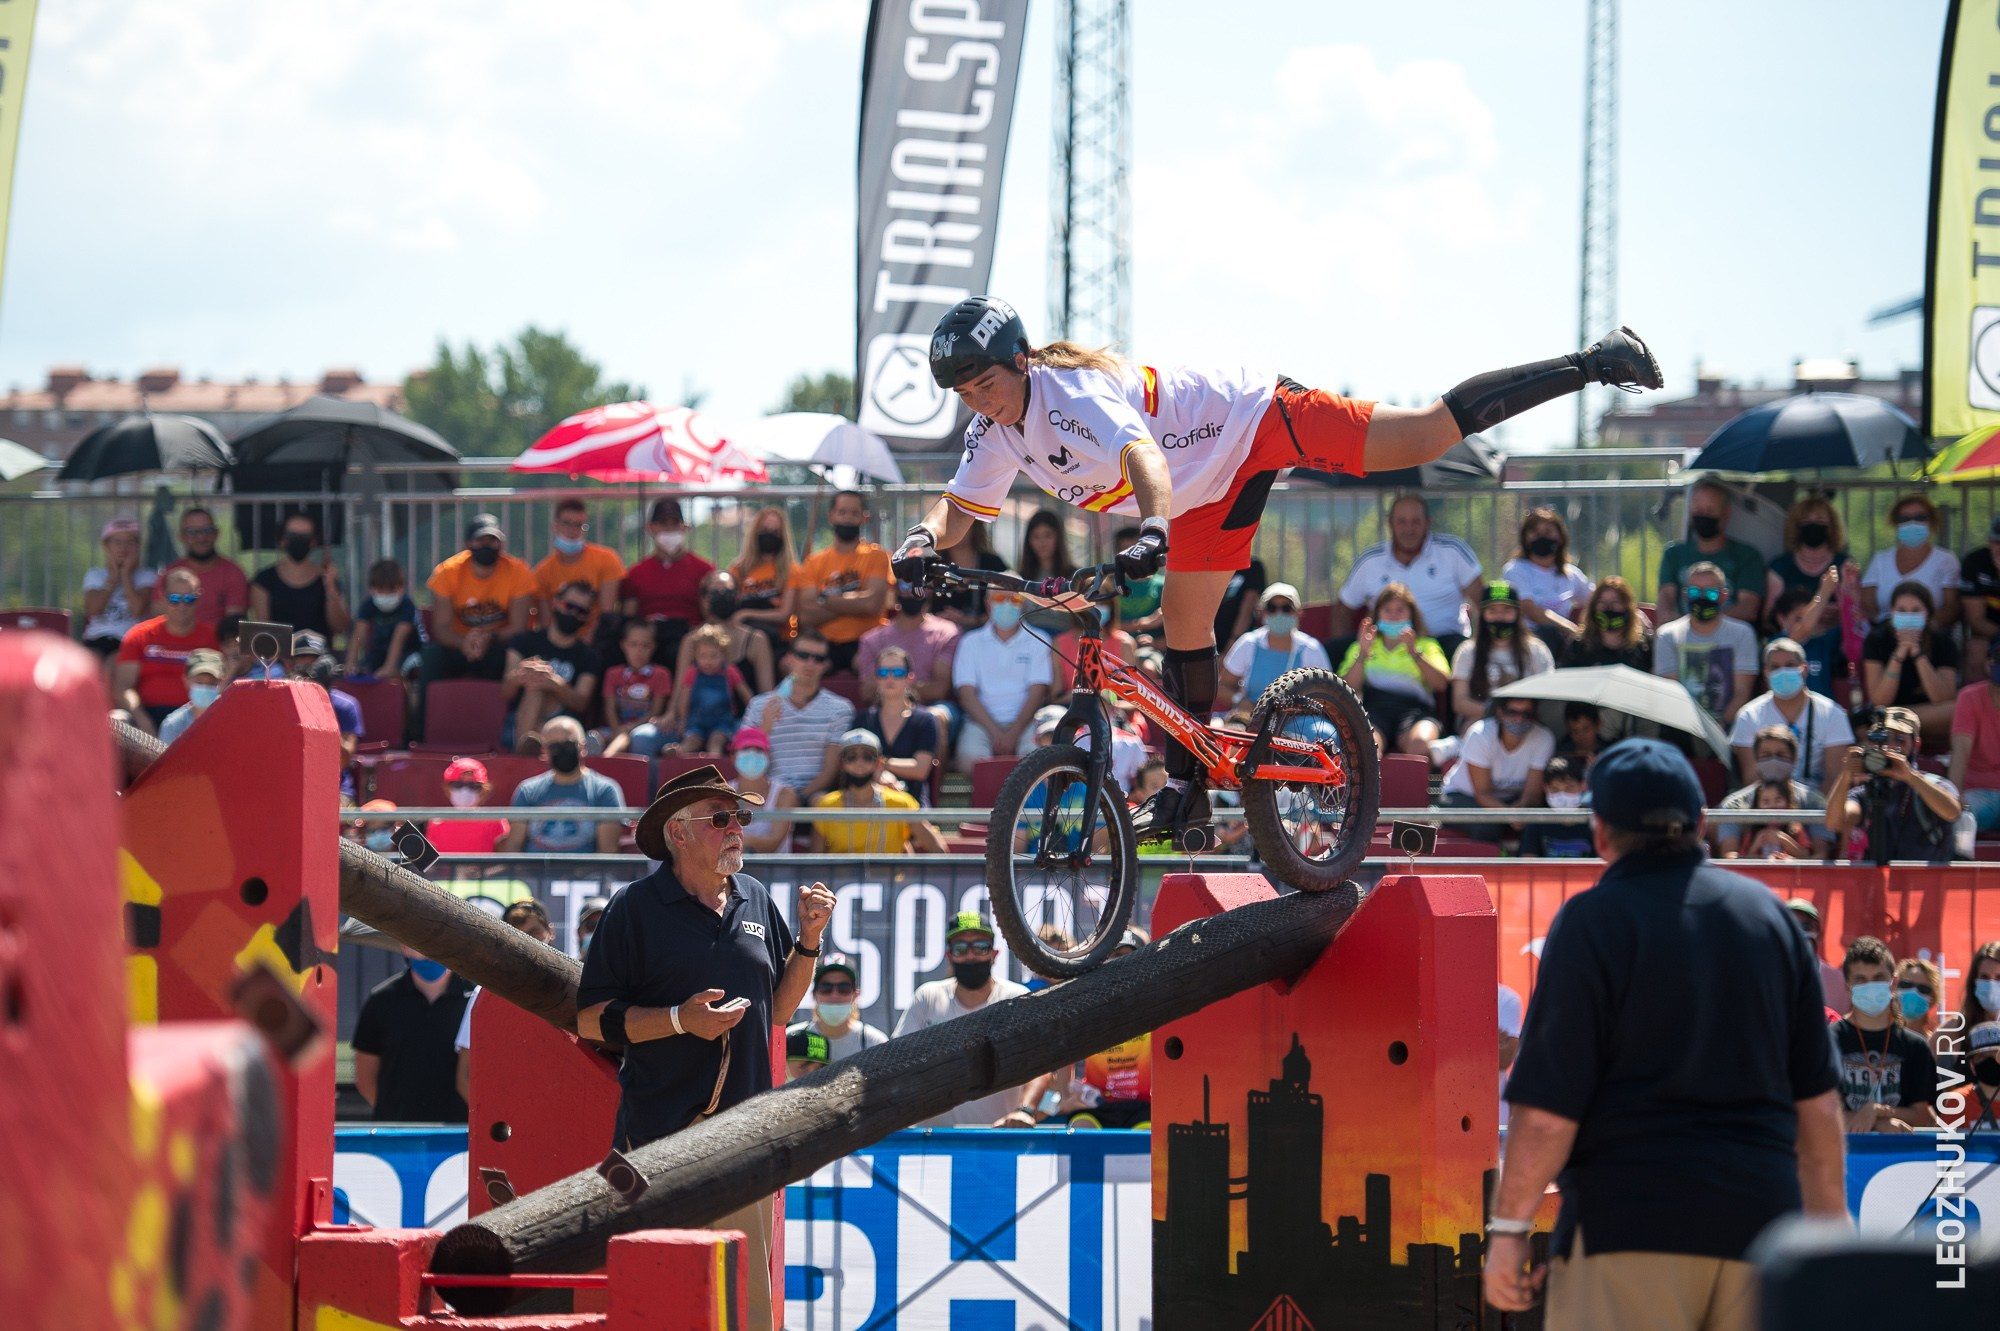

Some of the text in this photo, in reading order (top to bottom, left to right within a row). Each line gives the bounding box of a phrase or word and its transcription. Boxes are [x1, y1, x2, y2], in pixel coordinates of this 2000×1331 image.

[968, 301, 1017, 351] DAVE
[1048, 409, 1100, 447] Cofidis
[1161, 422, 1224, 450] Cofidis
